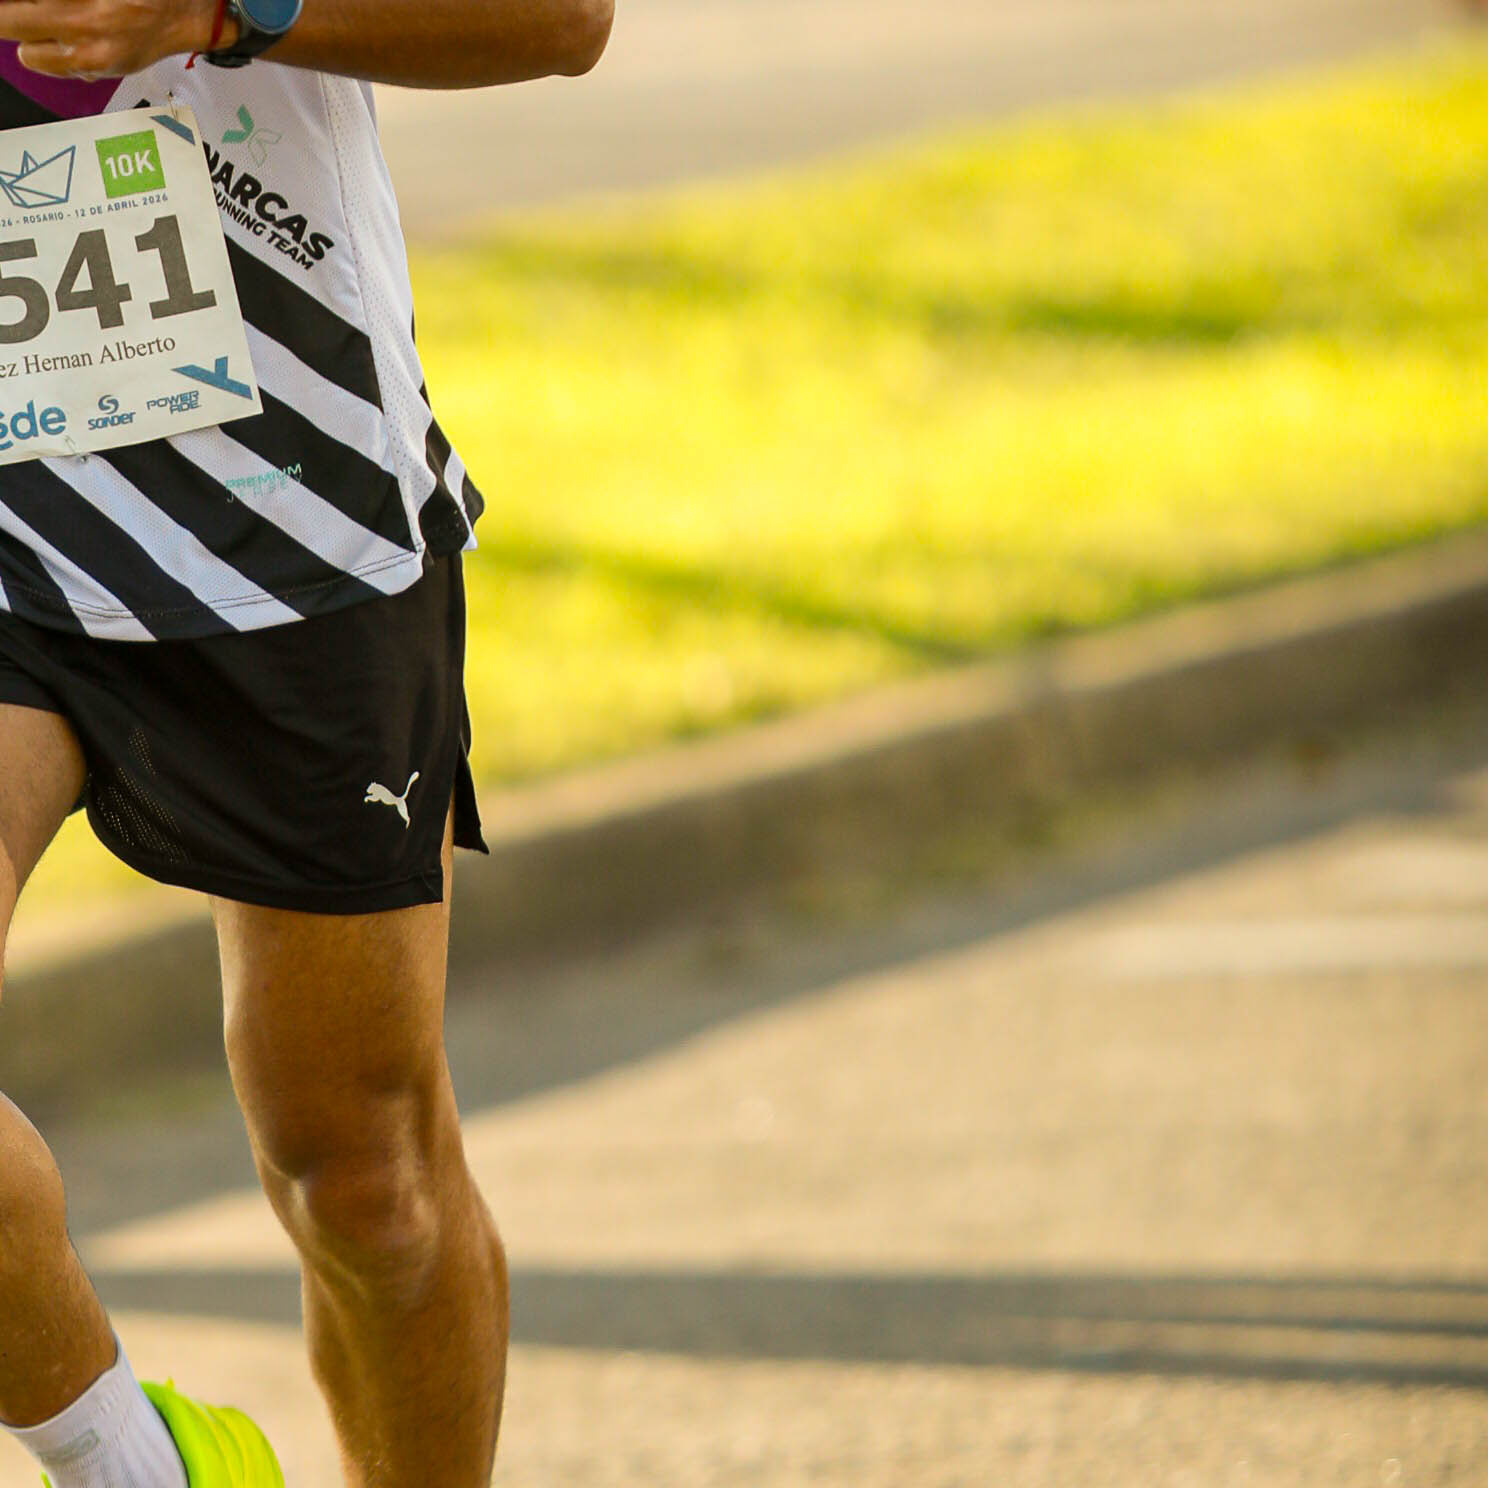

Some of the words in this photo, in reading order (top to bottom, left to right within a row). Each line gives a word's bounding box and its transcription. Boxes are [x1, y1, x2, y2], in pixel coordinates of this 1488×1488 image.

[105, 149, 156, 180] 10K
[23, 212, 63, 224] ROSARIO
[75, 209, 86, 218] 12
[90, 205, 103, 216] DE
[107, 199, 138, 212] ABRIL
[142, 193, 168, 205] 2026
[214, 187, 267, 237] UNNING
[267, 230, 314, 270] TEAM
[23, 352, 93, 375] Hernan
[100, 336, 176, 364] Alberto
[146, 391, 199, 410] POWER
